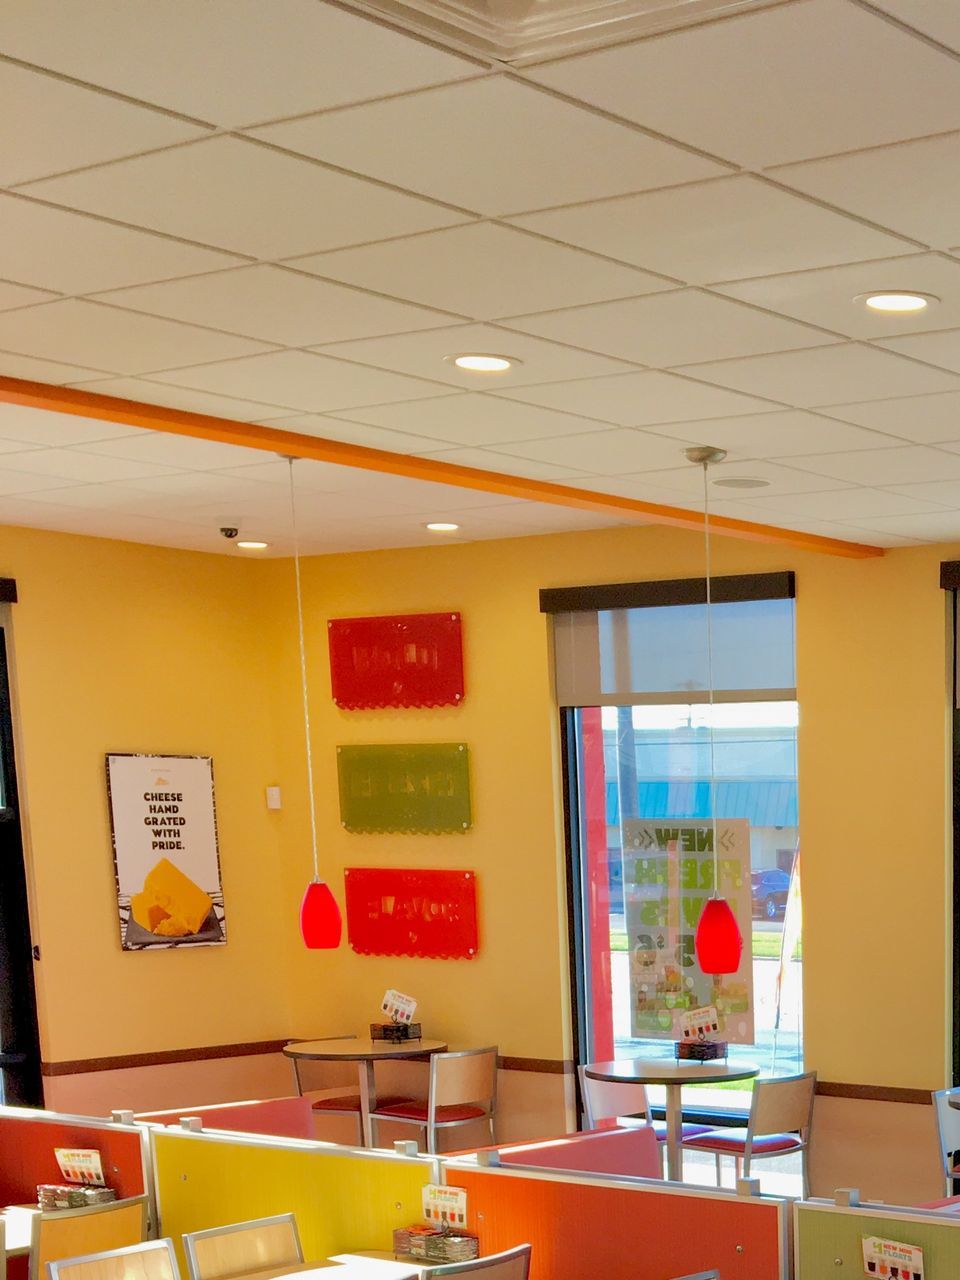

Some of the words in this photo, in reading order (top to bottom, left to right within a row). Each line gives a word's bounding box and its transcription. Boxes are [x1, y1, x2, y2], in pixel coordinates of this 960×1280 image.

[143, 792, 183, 802] CHEESE
[149, 805, 179, 814] HAND
[144, 817, 186, 826] GRATED
[152, 829, 180, 838] WITH
[152, 841, 185, 850] PRIDE.
